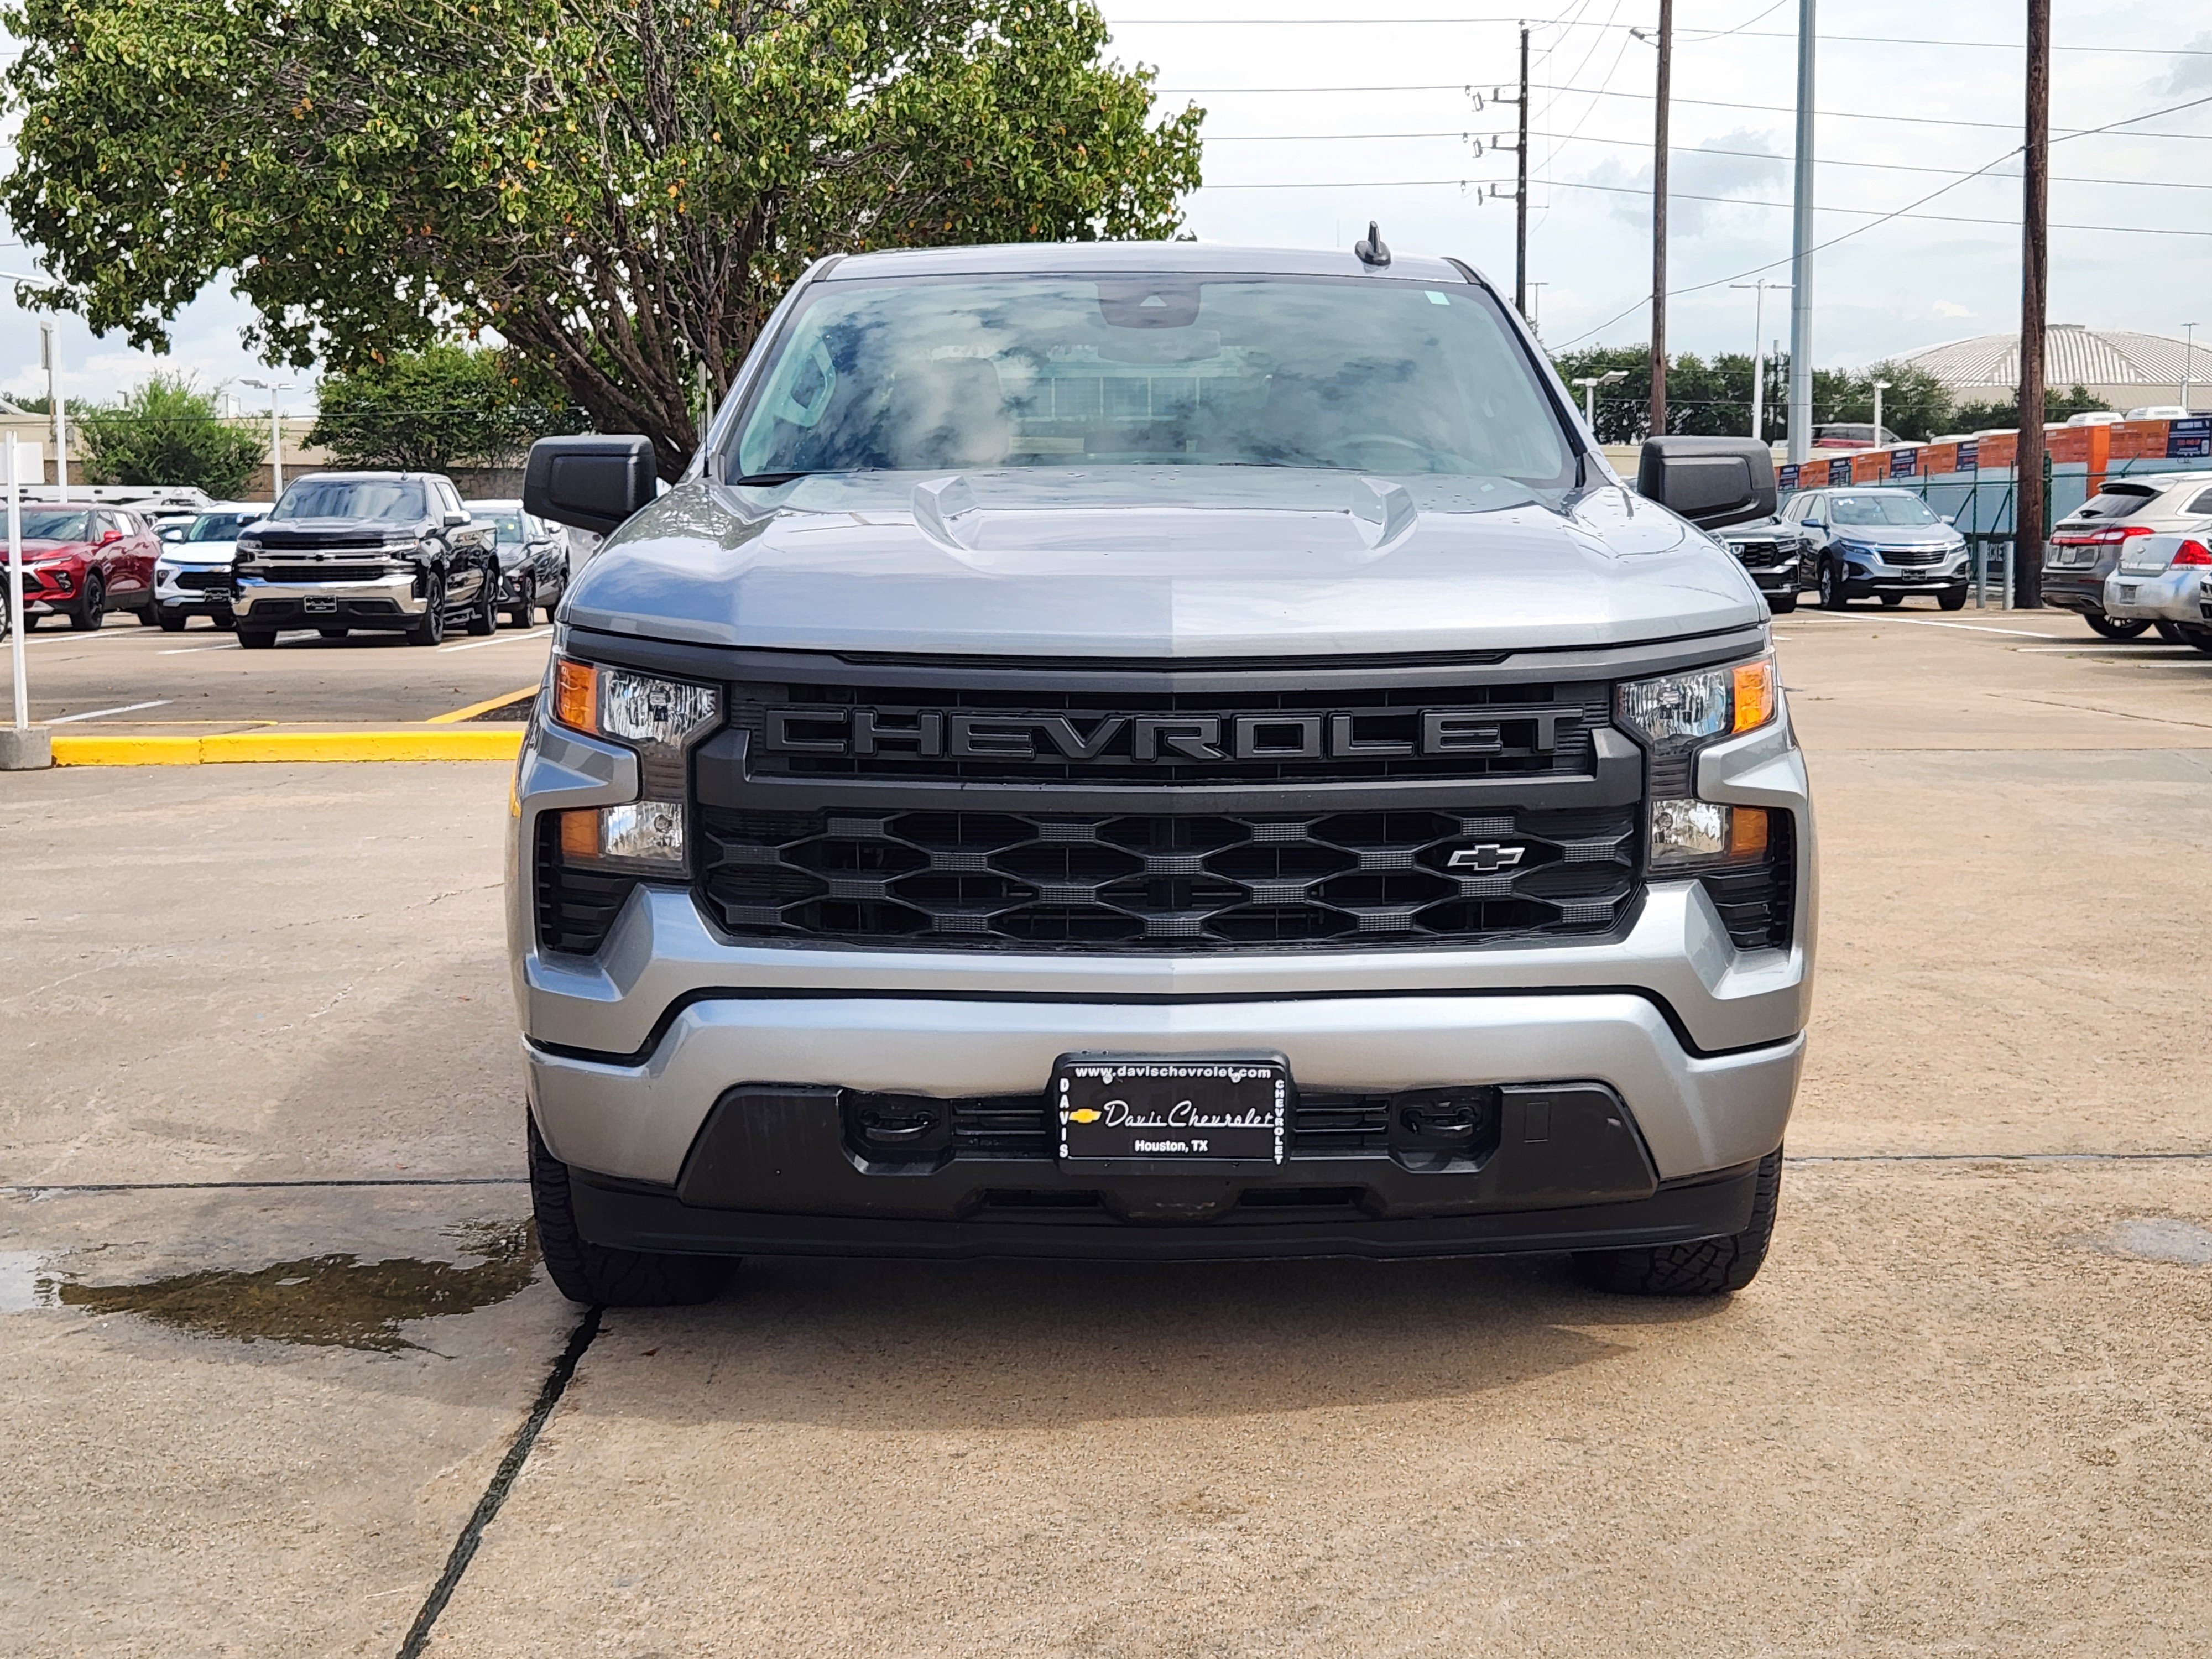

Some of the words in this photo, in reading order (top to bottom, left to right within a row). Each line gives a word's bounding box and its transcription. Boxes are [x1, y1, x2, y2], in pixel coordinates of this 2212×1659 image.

[765, 708, 1584, 761] CHEVROLET
[1074, 1065, 1271, 1078] www.davischevroletcom
[1059, 1078, 1069, 1158] DAVIS
[1104, 1100, 1167, 1127] Davis
[1168, 1100, 1274, 1127] Chevrolet
[1274, 1079, 1285, 1165] CHEVROLET
[1135, 1140, 1189, 1153] Houston,
[1191, 1140, 1208, 1151] TX
